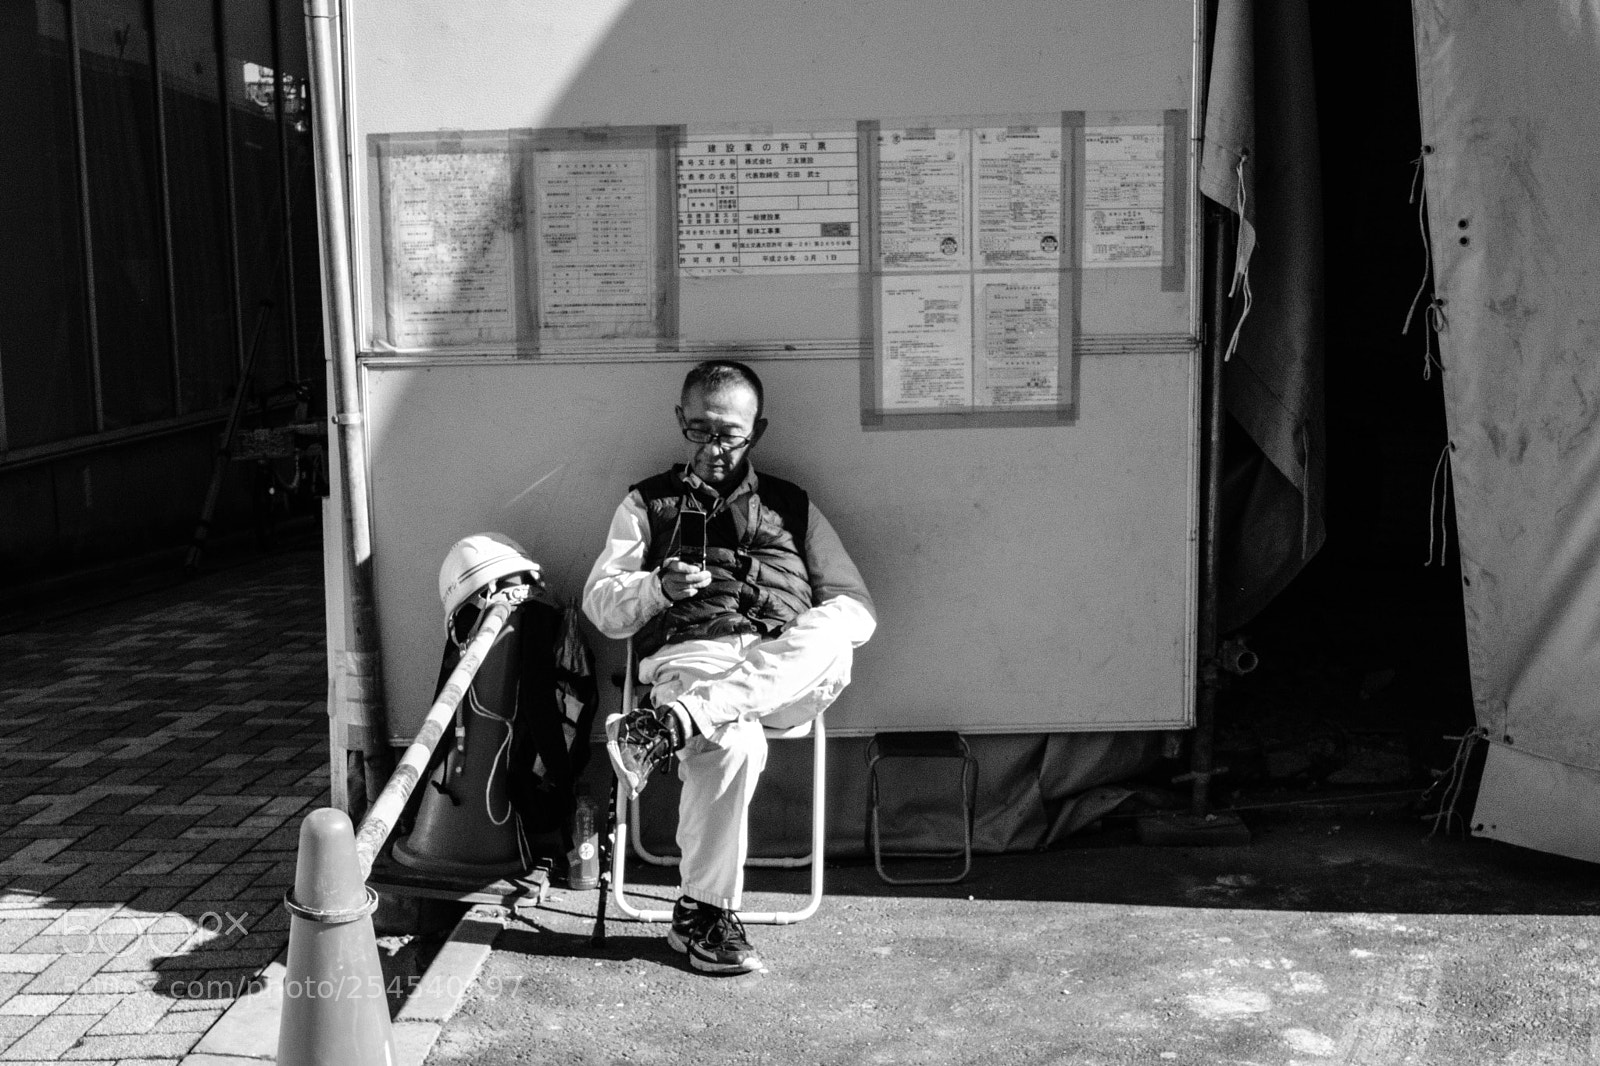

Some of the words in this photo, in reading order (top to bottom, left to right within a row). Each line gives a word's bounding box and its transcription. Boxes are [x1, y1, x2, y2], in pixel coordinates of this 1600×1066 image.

[707, 141, 827, 153] 建設業の許可票
[745, 157, 773, 165] 株式会社
[677, 172, 736, 180] 代表者の氏名
[745, 171, 780, 179] 代表取締役
[746, 213, 780, 221] 一般建設業
[747, 227, 780, 235] 解体工事業
[680, 242, 738, 250] 許可番号
[680, 256, 738, 264] 許可年月日
